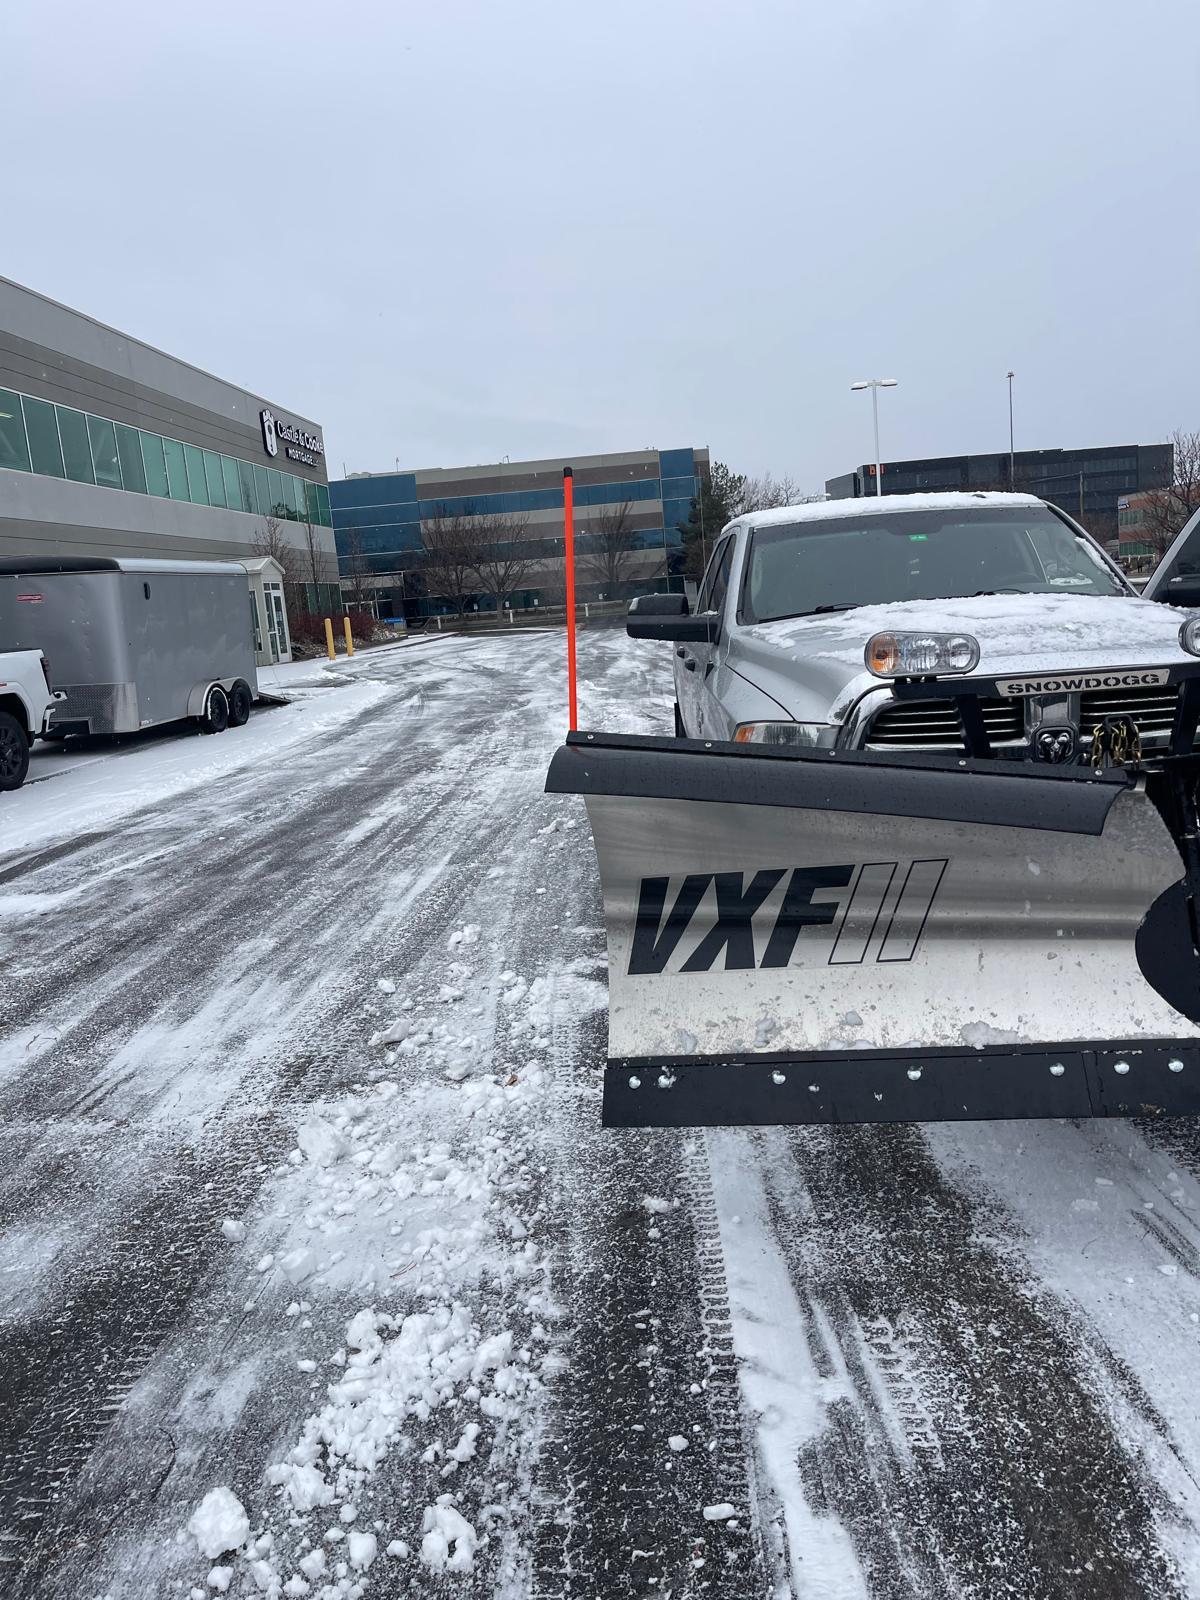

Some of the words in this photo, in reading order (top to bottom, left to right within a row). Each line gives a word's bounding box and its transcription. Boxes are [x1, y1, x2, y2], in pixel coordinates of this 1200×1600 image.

[276, 420, 299, 444] Castle
[304, 432, 324, 454] Cooke
[287, 447, 314, 466] MORTGAGE
[1007, 673, 1160, 694] SNOWDOGG
